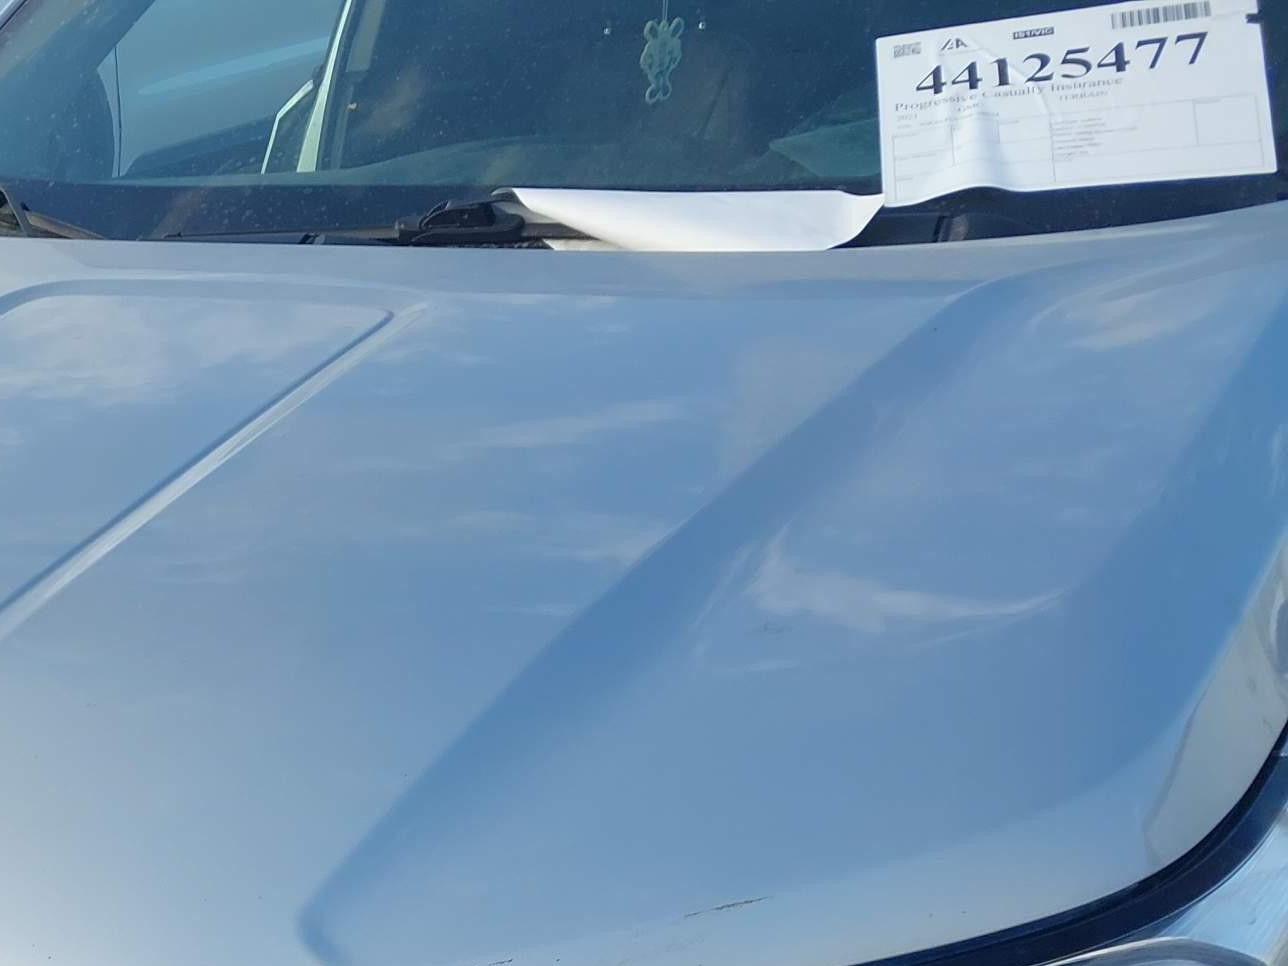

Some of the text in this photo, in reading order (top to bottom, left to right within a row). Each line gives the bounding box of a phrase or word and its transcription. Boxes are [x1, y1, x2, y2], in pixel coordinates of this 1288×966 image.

[915, 30, 1209, 95] 44125477
[894, 77, 1124, 112] Progressive Casualty Insurance
